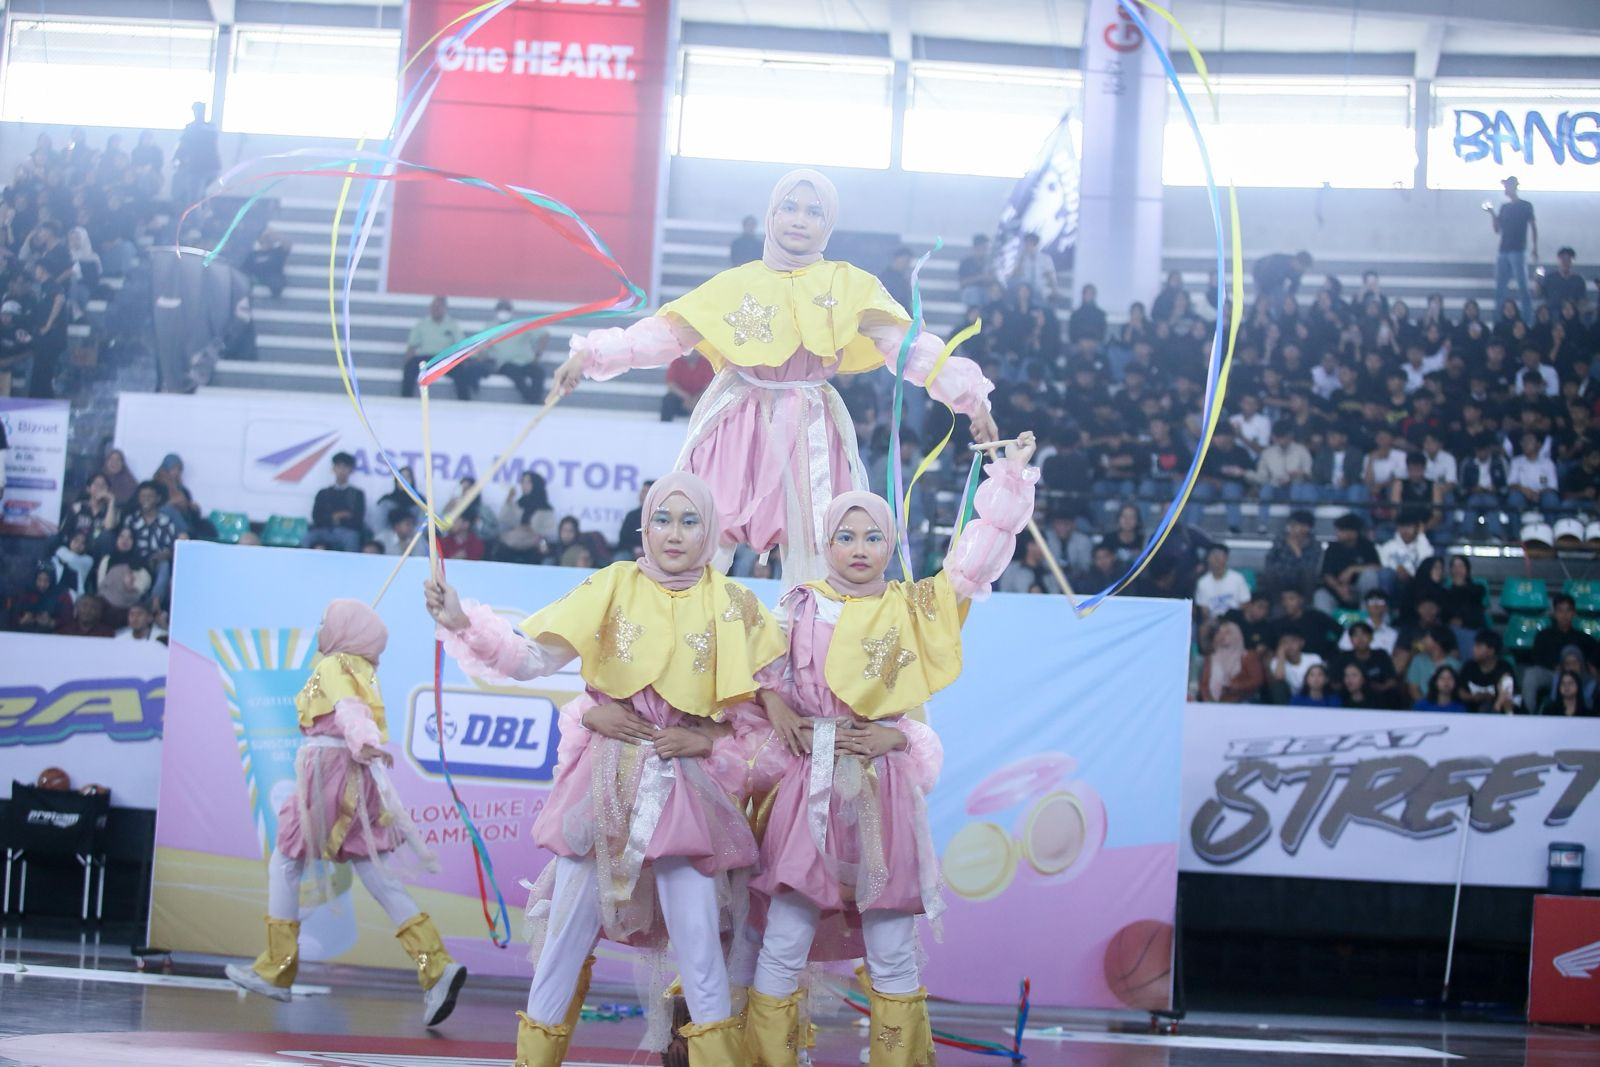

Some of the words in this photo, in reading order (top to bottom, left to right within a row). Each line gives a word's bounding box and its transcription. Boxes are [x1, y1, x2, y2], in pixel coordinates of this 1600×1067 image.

[436, 35, 508, 72] One
[513, 40, 636, 81] HEART.
[1454, 110, 1600, 166] BANG
[353, 448, 478, 482] ASTRA
[460, 714, 540, 751] DBL
[411, 804, 466, 823] LOW
[473, 801, 522, 819] LIKE
[1191, 750, 1600, 865] STREET
